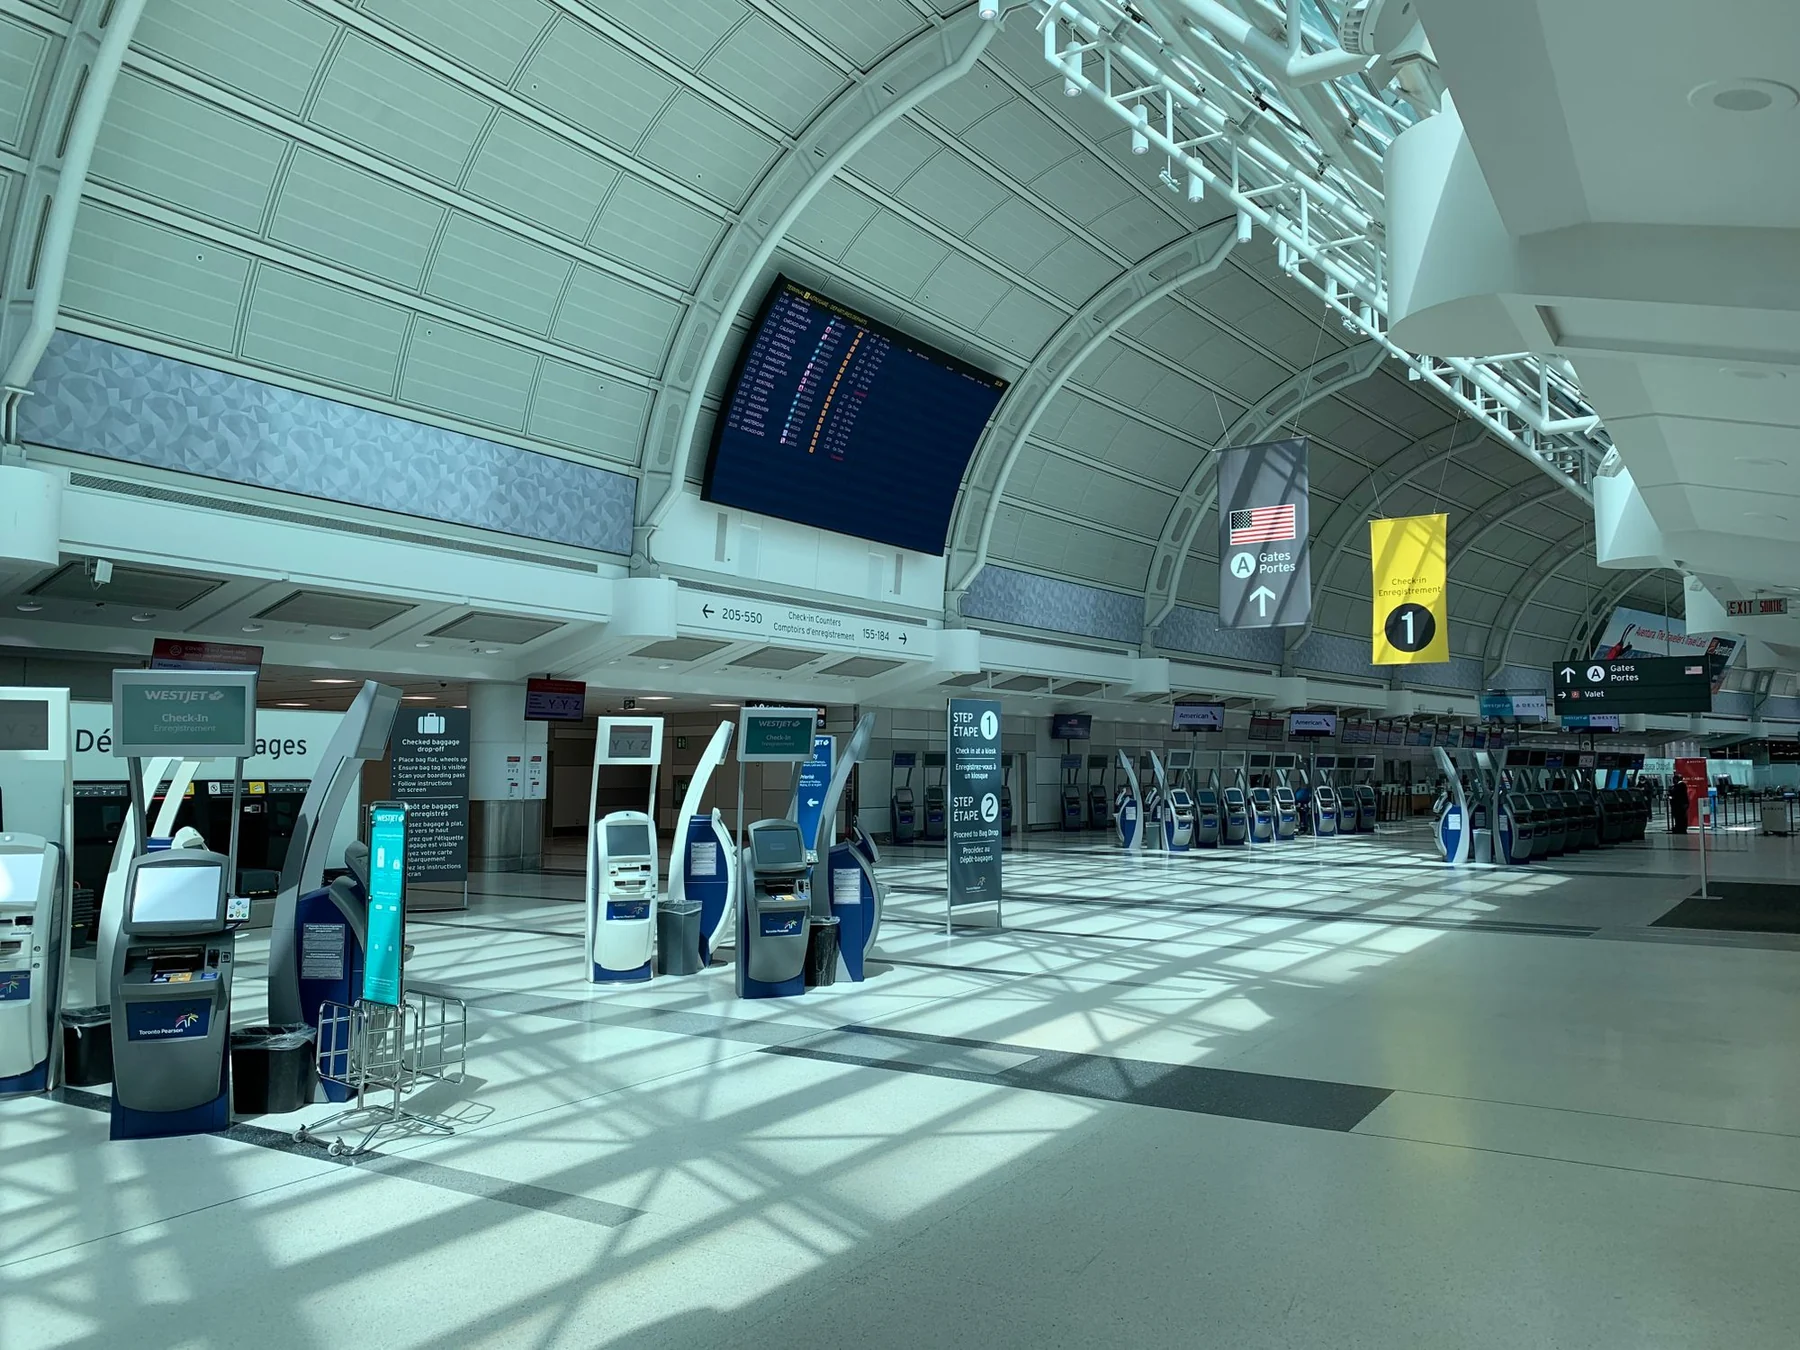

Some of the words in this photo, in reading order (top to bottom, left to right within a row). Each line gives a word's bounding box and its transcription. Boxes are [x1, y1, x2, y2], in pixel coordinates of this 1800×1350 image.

[1259, 551, 1291, 563] Gates
[1236, 556, 1250, 574] A
[1259, 562, 1296, 574] Portes
[1391, 576, 1427, 586] Check-in
[1378, 586, 1441, 597] Enregistrement
[1730, 600, 1753, 615] EXIT
[722, 607, 763, 624] 205-550
[788, 611, 815, 622] Check-in
[815, 615, 842, 627] Counters
[773, 622, 805, 635] Comptoirs
[806, 625, 855, 642] d'enregistrement
[1401, 611, 1414, 645] 1
[862, 628, 890, 641] 155-184
[1610, 664, 1635, 672] Gates
[1590, 668, 1601, 679] A
[1610, 674, 1639, 682] Portes
[144, 690, 208, 703] WESTJET
[1584, 690, 1604, 698] Valet
[162, 713, 209, 722] Check-In
[953, 711, 974, 723] STEP
[153, 724, 216, 733] Enregistrement
[758, 720, 792, 729] WESTJET
[953, 723, 979, 737] ÉTAPE
[985, 715, 991, 736] 1
[431, 739, 460, 747] baggage
[984, 747, 997, 755] kiosk
[955, 763, 993, 772] Enregistrez-vous
[971, 772, 989, 780] kiosque
[431, 803, 459, 811] bagages
[953, 796, 974, 807] STEP
[953, 808, 979, 822] ÉTAPE
[985, 796, 995, 818] 2
[376, 814, 398, 824] WESTJET
[953, 830, 973, 839] Proceed
[979, 830, 988, 838] Bag
[988, 829, 999, 837] Drop
[962, 846, 984, 854] Procédez
